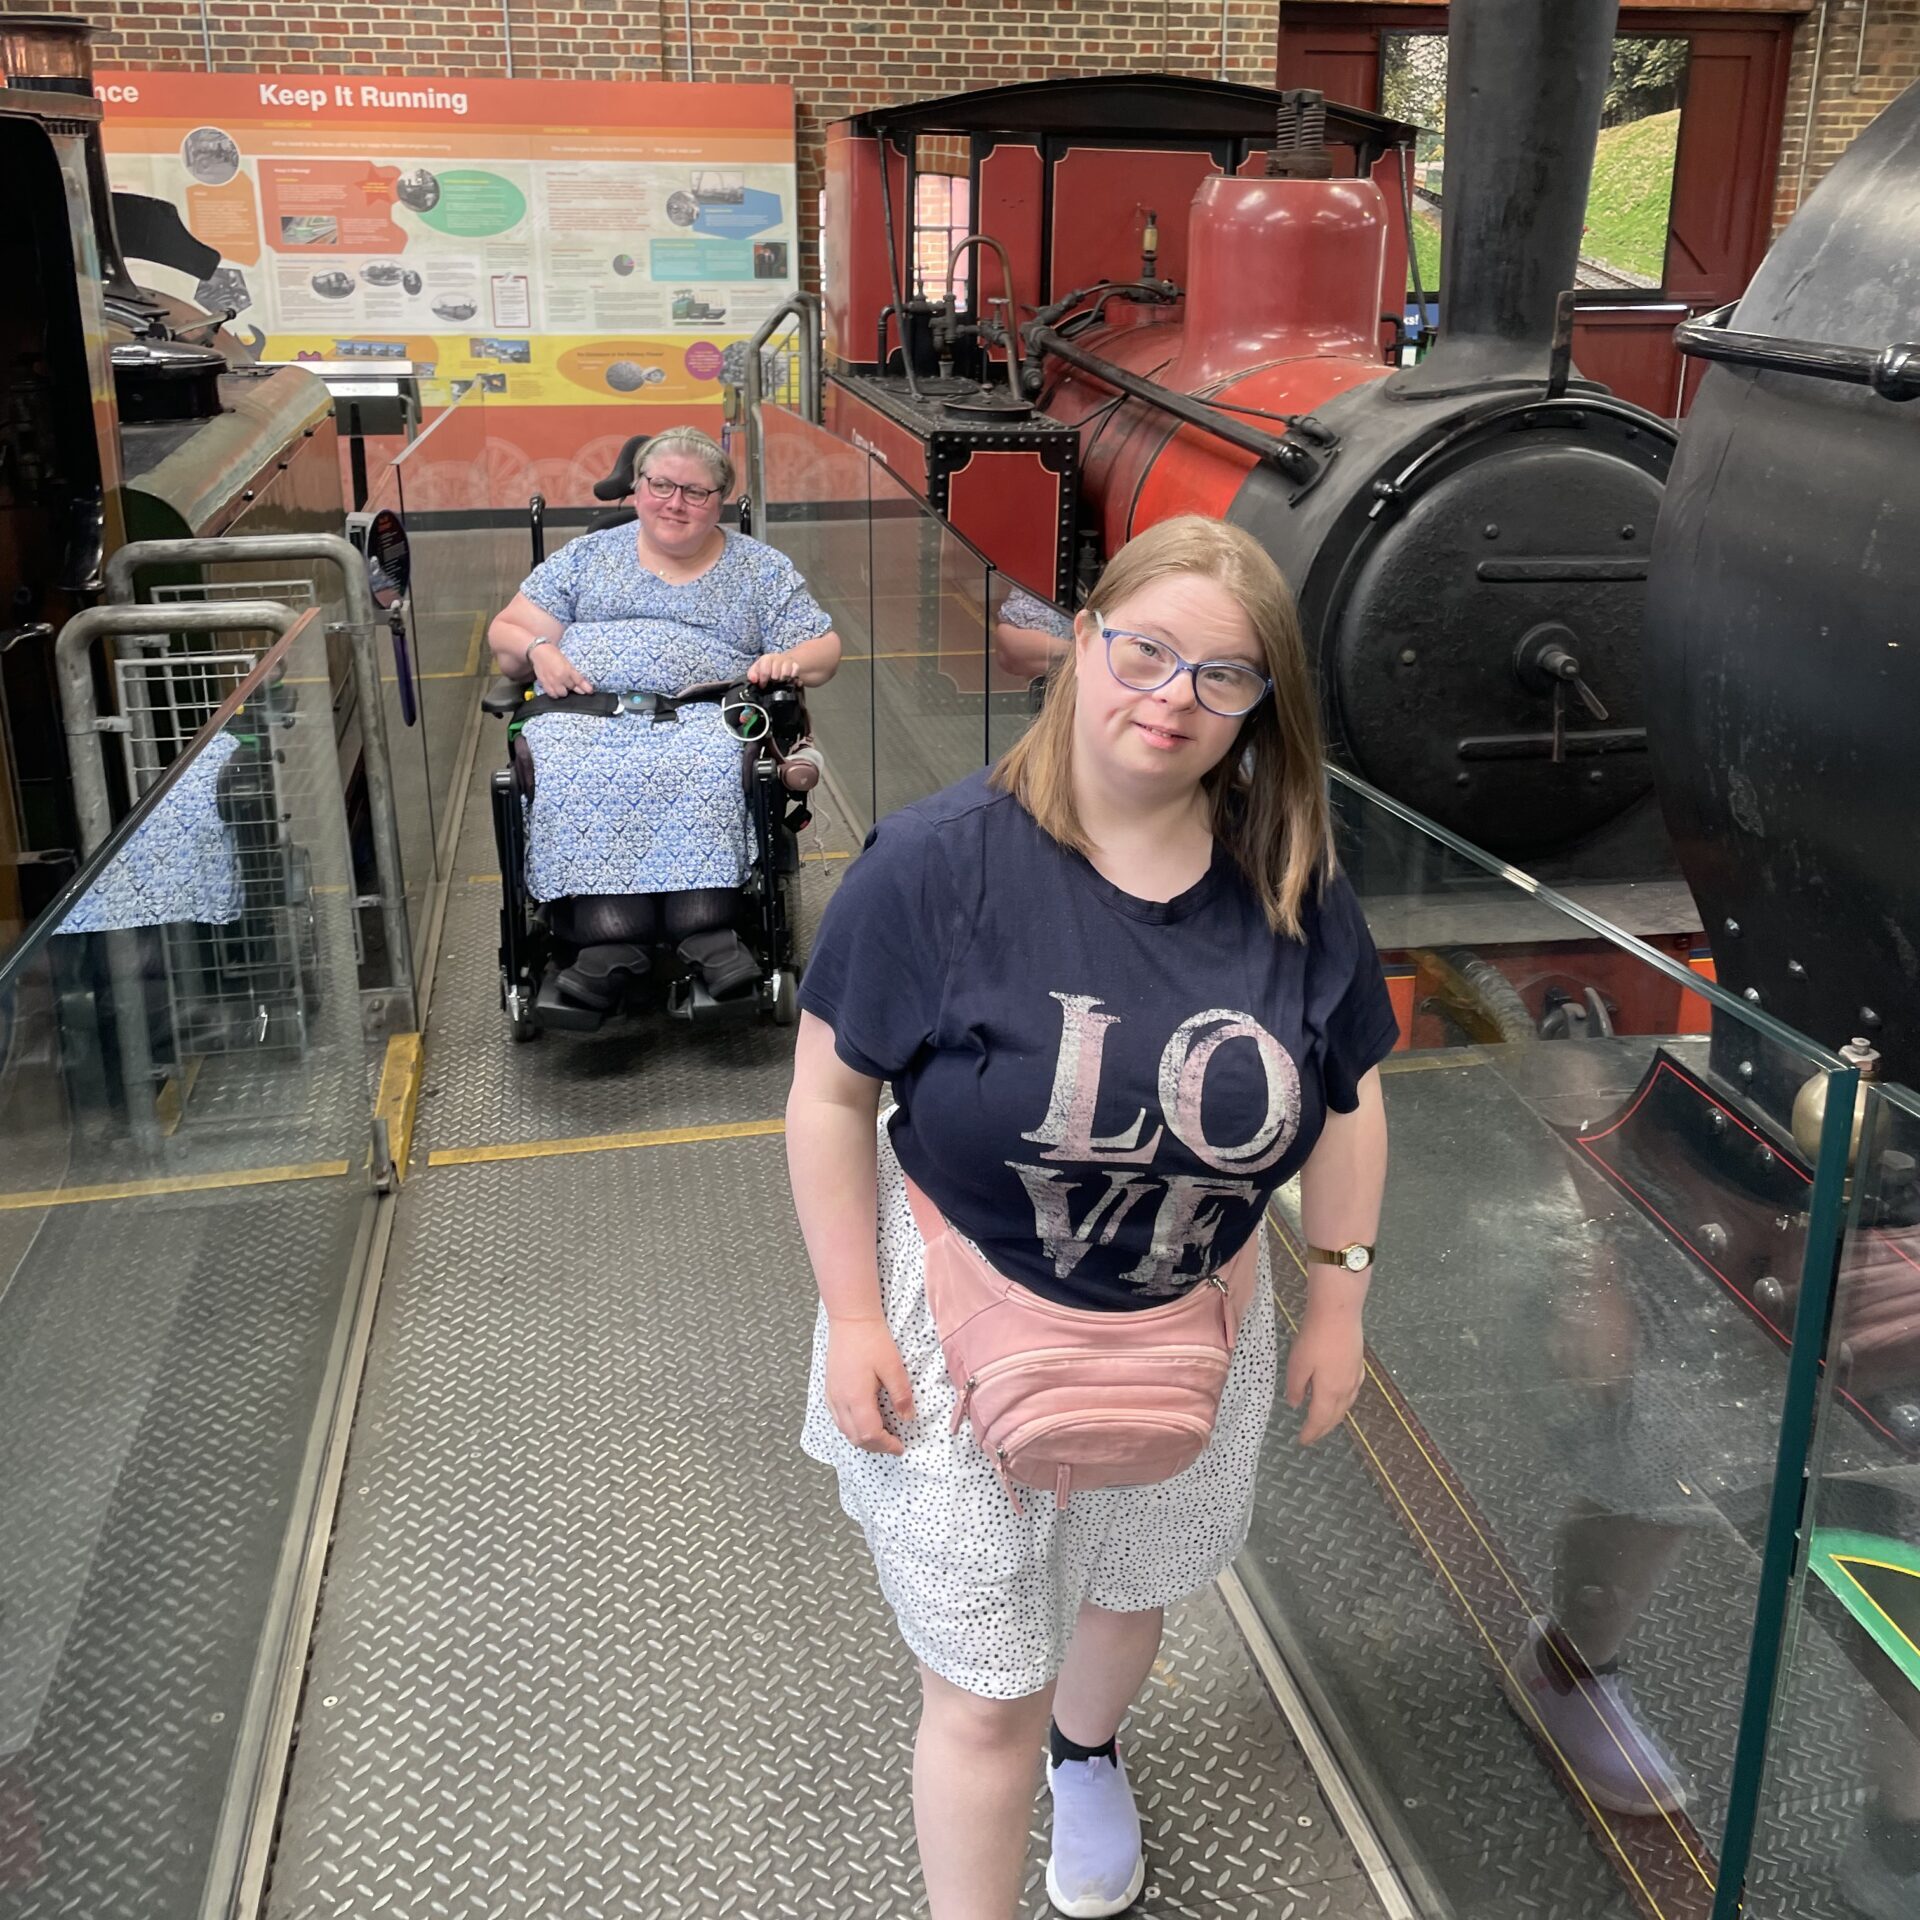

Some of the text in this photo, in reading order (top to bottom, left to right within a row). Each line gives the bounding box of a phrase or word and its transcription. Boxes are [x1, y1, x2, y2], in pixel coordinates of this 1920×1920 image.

[259, 83, 468, 115] Keep It Running
